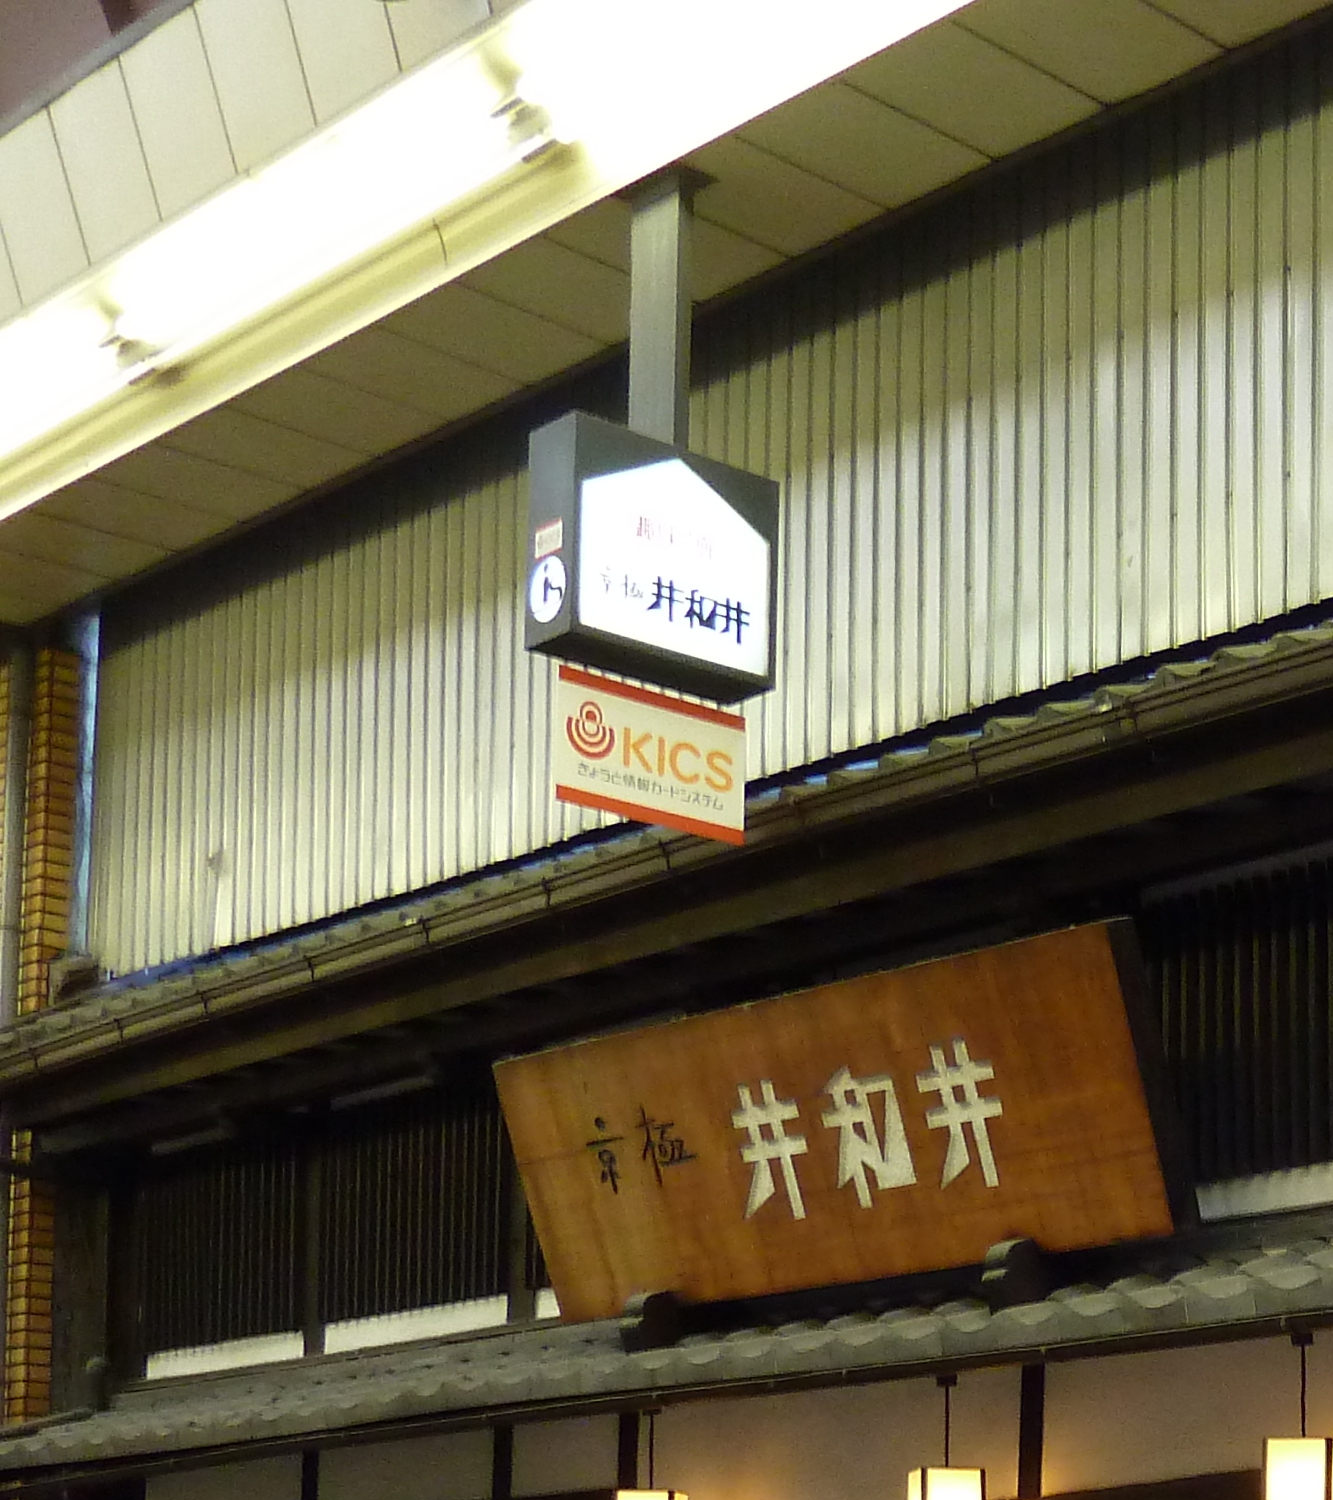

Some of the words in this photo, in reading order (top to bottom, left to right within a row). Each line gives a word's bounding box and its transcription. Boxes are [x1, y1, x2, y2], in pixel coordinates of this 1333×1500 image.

[577, 761, 724, 811] きょうと情報カードシステム
[622, 726, 733, 793] KICS
[586, 1106, 697, 1194] 京極
[730, 1036, 1004, 1221] 井和井
